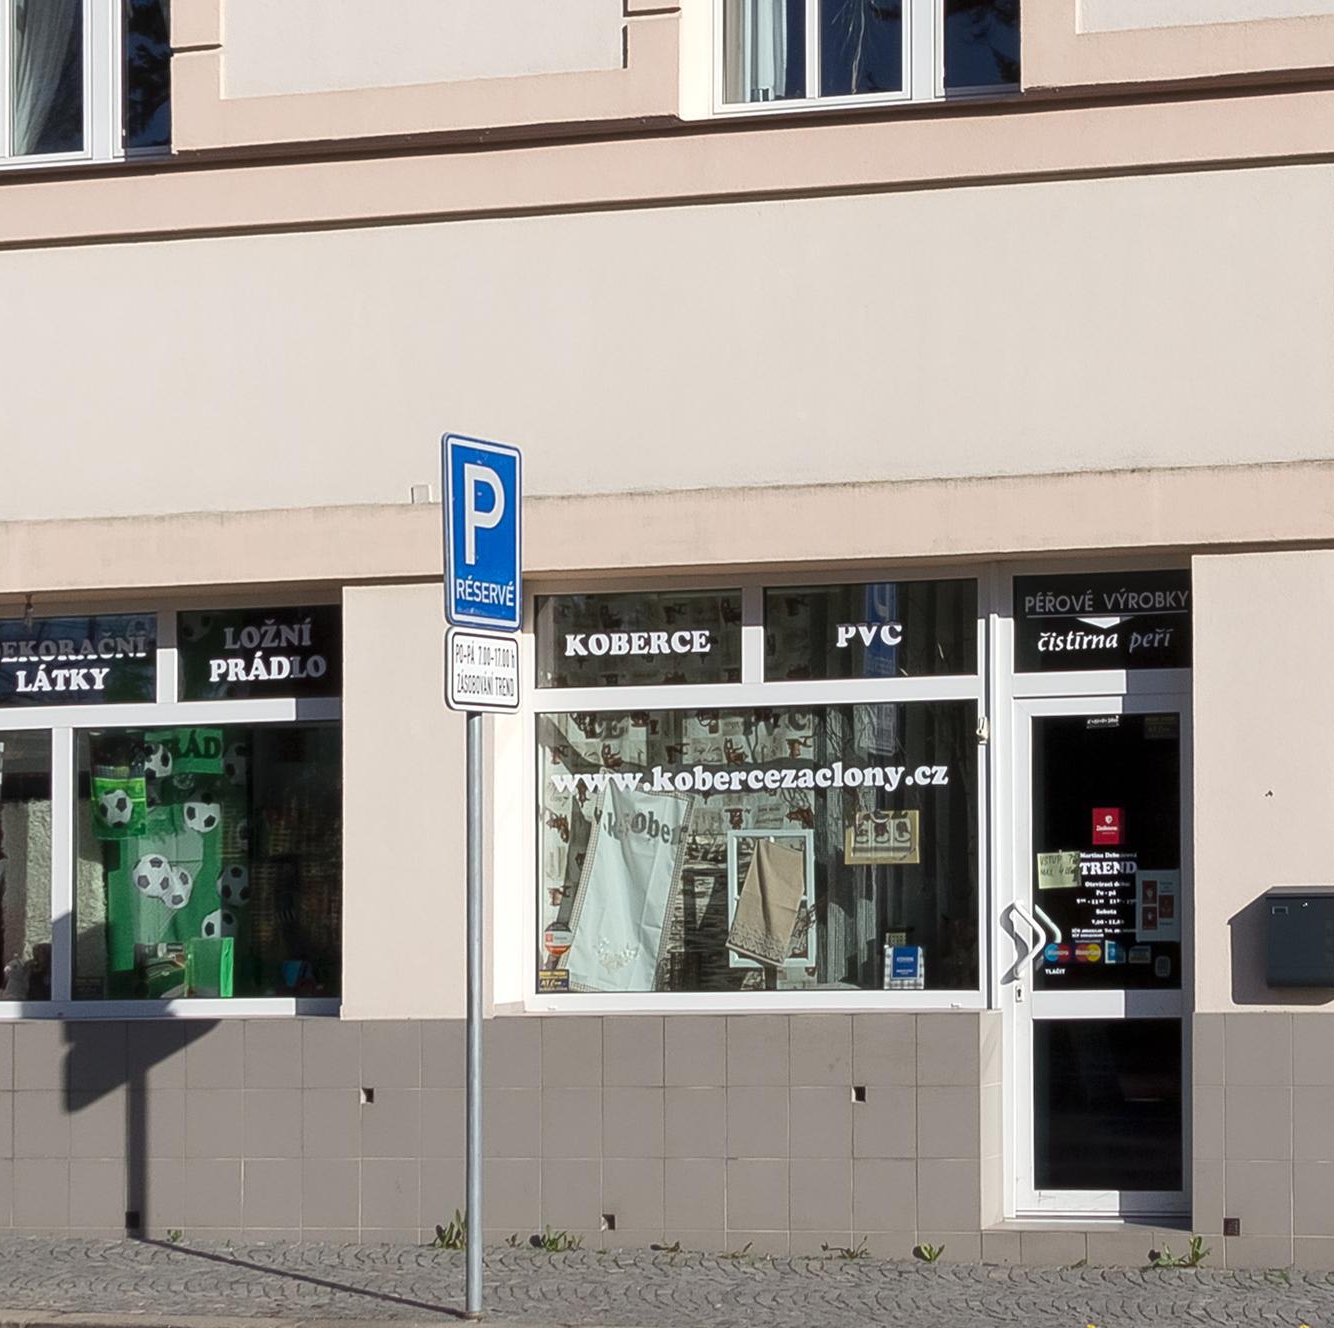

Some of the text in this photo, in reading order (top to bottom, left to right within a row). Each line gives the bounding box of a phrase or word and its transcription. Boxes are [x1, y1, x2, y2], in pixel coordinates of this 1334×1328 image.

[464, 462, 505, 565] P
[456, 575, 514, 606] RÉSERVÉ
[1025, 588, 1190, 612] PÉŘOVÉ VÝROBKY
[223, 618, 313, 649] LOŽNÍ
[564, 630, 711, 658] KOBERCE
[835, 622, 903, 648] PVC
[1037, 628, 1174, 653] čistírna peří
[16, 664, 111, 693] LÁTKY
[209, 650, 327, 683] PRÁDLO
[457, 665, 515, 698] ZÁSOBOVÁNÍ TREND
[552, 761, 950, 794] www.kobercezaclony.cz
[1080, 861, 1137, 875] TREND
